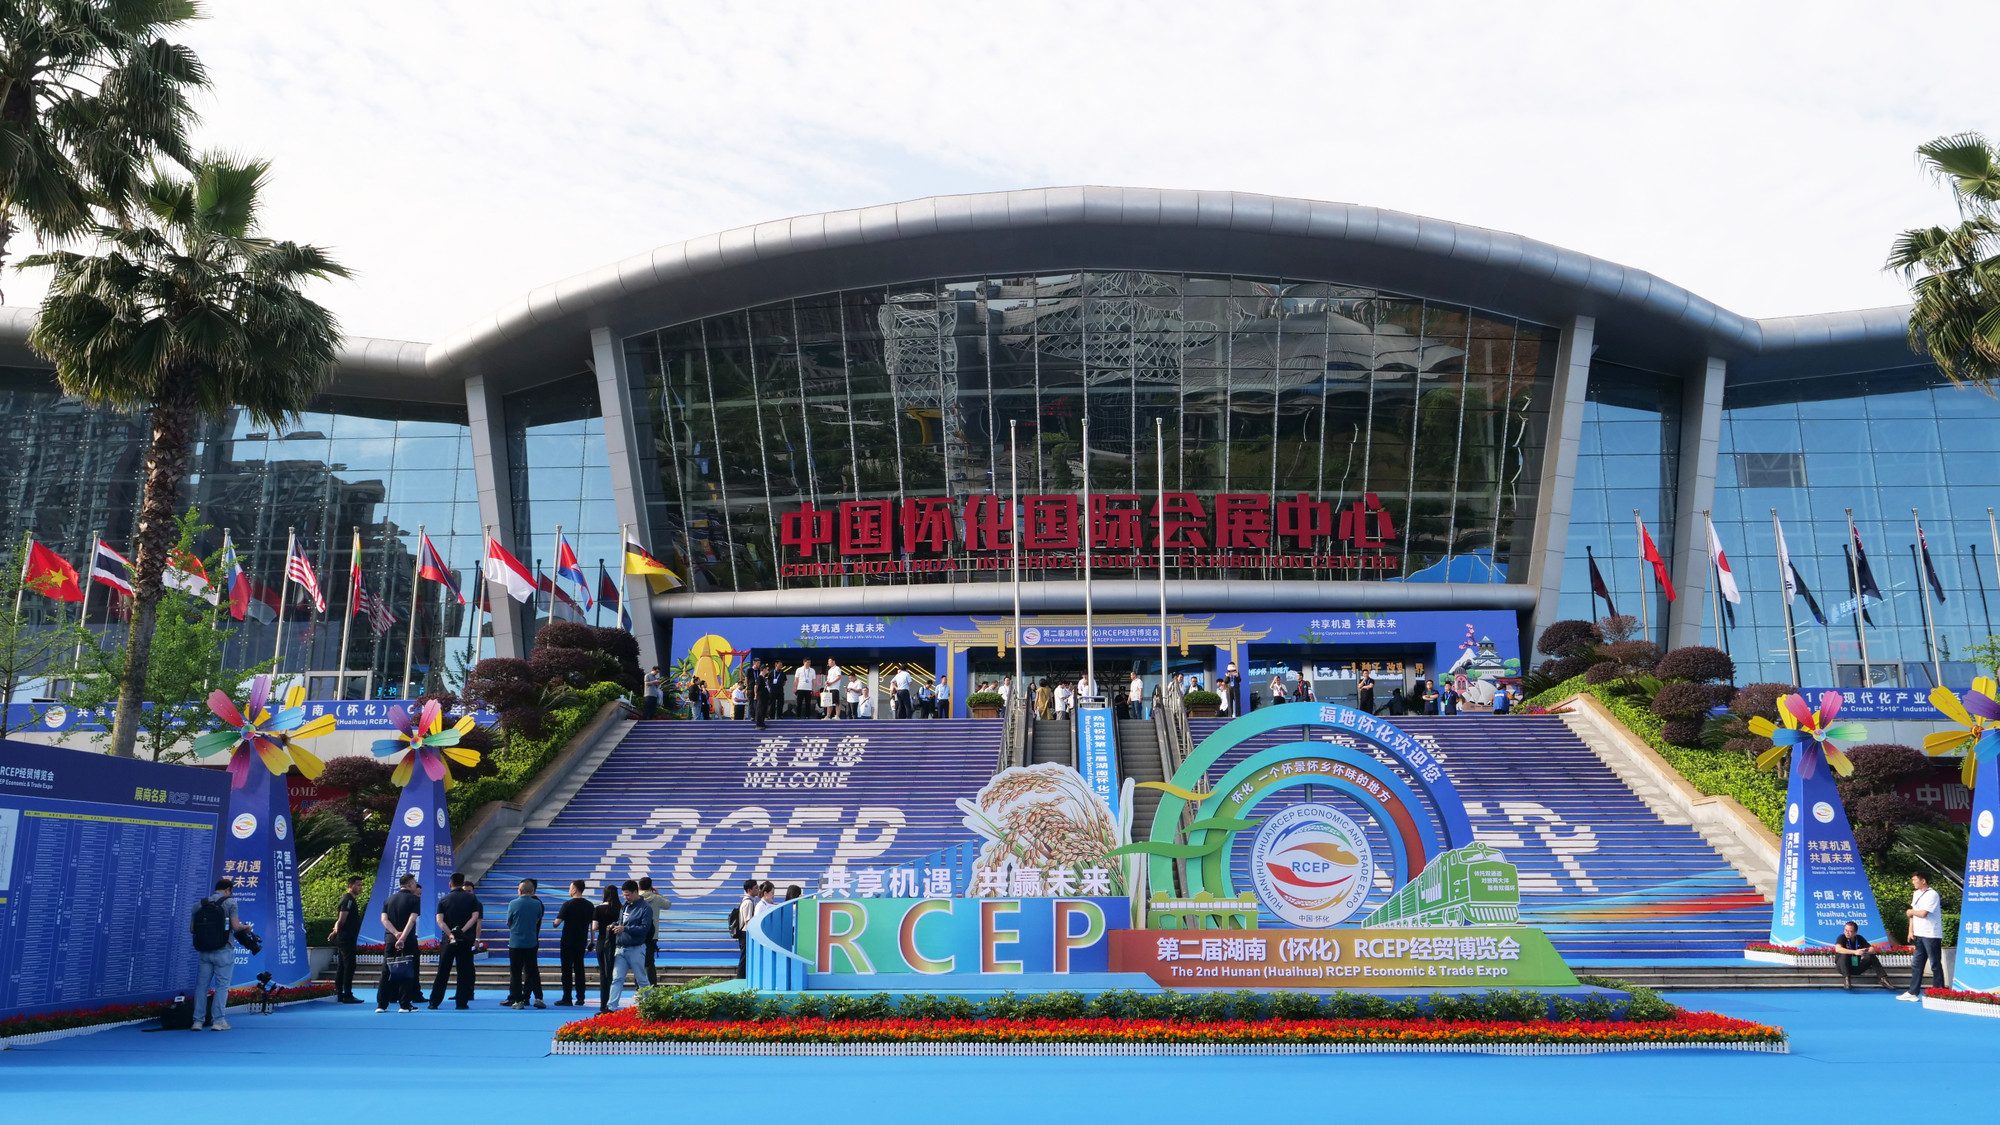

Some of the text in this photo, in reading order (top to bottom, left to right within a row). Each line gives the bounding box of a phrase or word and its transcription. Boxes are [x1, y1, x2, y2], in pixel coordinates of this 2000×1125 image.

[781, 492, 1396, 557] 中国怀化国际会展中心
[781, 561, 846, 577] CHINA
[977, 555, 1160, 570] INTERNATIONAL
[1179, 554, 1305, 568] EXHIBITION
[1312, 555, 1399, 570] CENTER
[801, 623, 885, 633] 共享机遇 共赢未来
[1311, 619, 1396, 629] 共享机遇 共赢未来
[337, 718, 368, 726] (Huaihua)
[746, 735, 869, 767] 欢迎您
[1319, 705, 1442, 784] 福地怀化欢迎您
[0, 766, 55, 782] RCEP经贸博览会
[743, 771, 851, 789] WELCOME
[6, 779, 26, 787] Economic
[1230, 782, 1255, 805] 怀化
[1258, 760, 1392, 804] 一个怀景怀乡怀味的地方
[134, 786, 167, 804] 展商名录
[288, 787, 318, 797] OME
[1297, 808, 1350, 830] ECONOMIC
[1347, 827, 1363, 847] AND
[1808, 840, 1851, 851] 共享机遇
[583, 806, 908, 899] RCEP
[1809, 853, 1854, 863] 共赢未来
[224, 860, 261, 874] 享机遇
[1291, 861, 1330, 873] RCEP
[1359, 848, 1369, 882] TRADE
[1968, 859, 1999, 872] 共享机遇
[821, 866, 1112, 899] 共享机遇 共赢未来
[1968, 875, 1999, 888] 共赢未来
[1346, 883, 1366, 909] EXPO
[1813, 890, 1863, 901] 中国·怀化
[816, 899, 1106, 975] RCEP
[234, 947, 250, 955] hina
[1964, 947, 2000, 957] Huaihua, China
[234, 957, 249, 965] 025
[1987, 958, 2000, 967] 2025
[1171, 966, 1508, 979] The 2nd Hunan (Huaihua) RCEP Economic & Trade Expo
